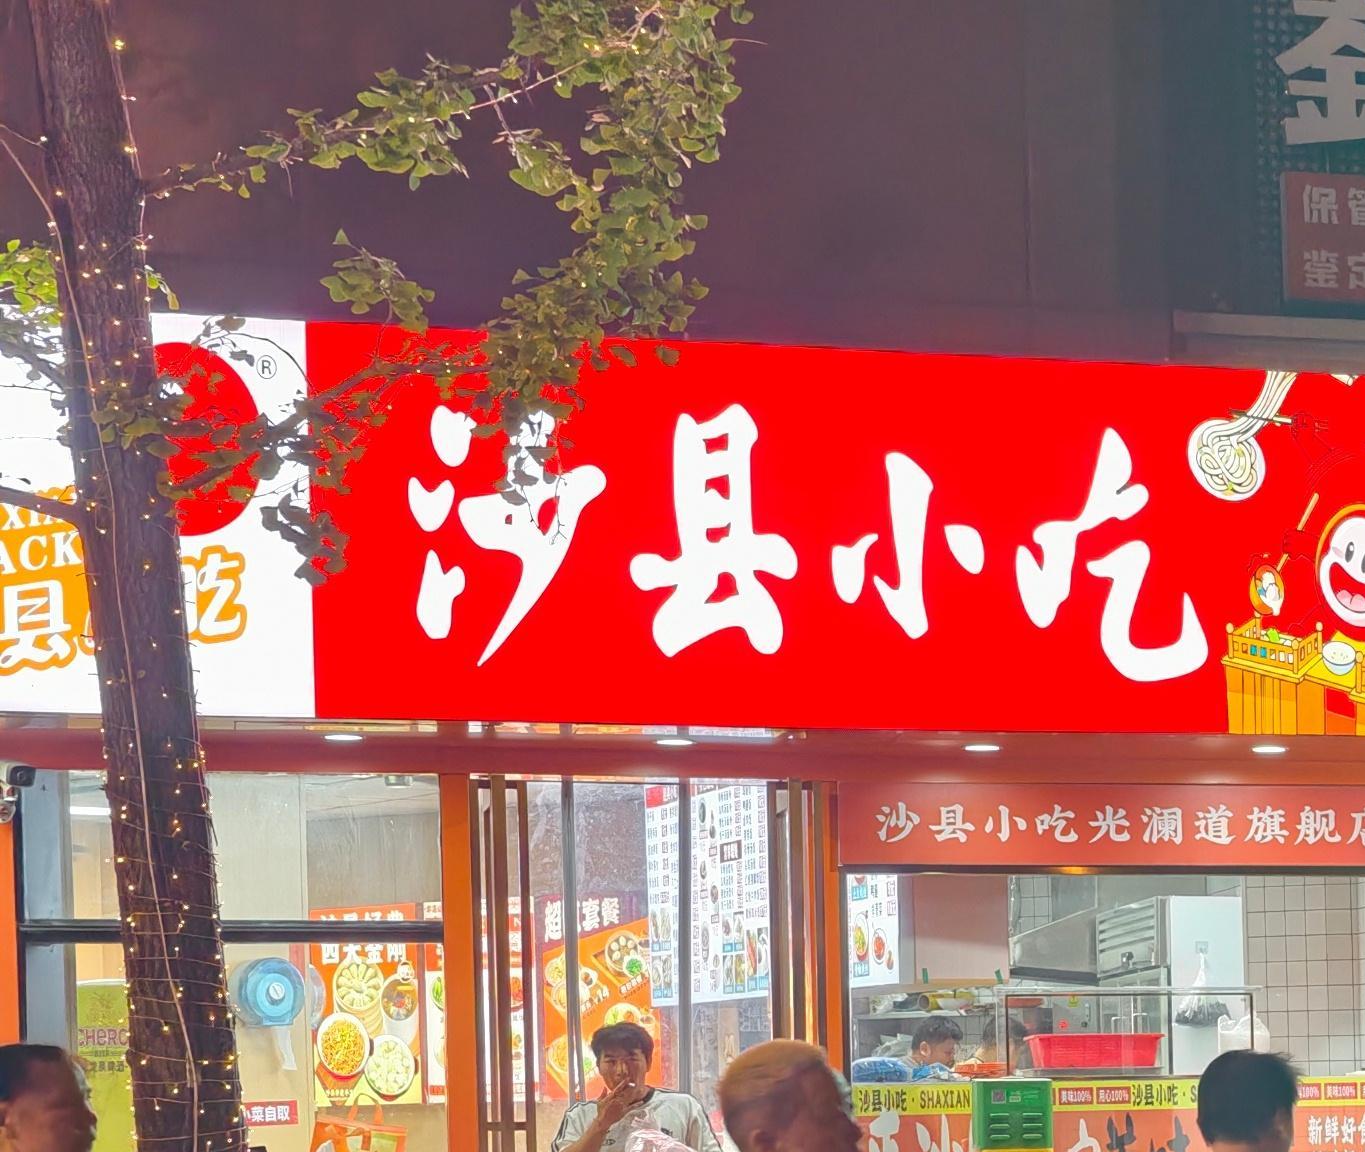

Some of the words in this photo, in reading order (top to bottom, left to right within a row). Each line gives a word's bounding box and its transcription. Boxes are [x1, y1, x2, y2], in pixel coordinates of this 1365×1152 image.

[408, 404, 1207, 682] 沙县小吃
[545, 897, 620, 942] 超套餐
[858, 1087, 907, 1112] 沙县小吃
[920, 1088, 970, 1108] SHAXIAN
[1060, 1089, 1092, 1104] 美味100%
[1097, 1088, 1130, 1104] 用心100%
[1132, 1084, 1179, 1107] 沙县小吃
[1326, 1085, 1355, 1098] 美味100%
